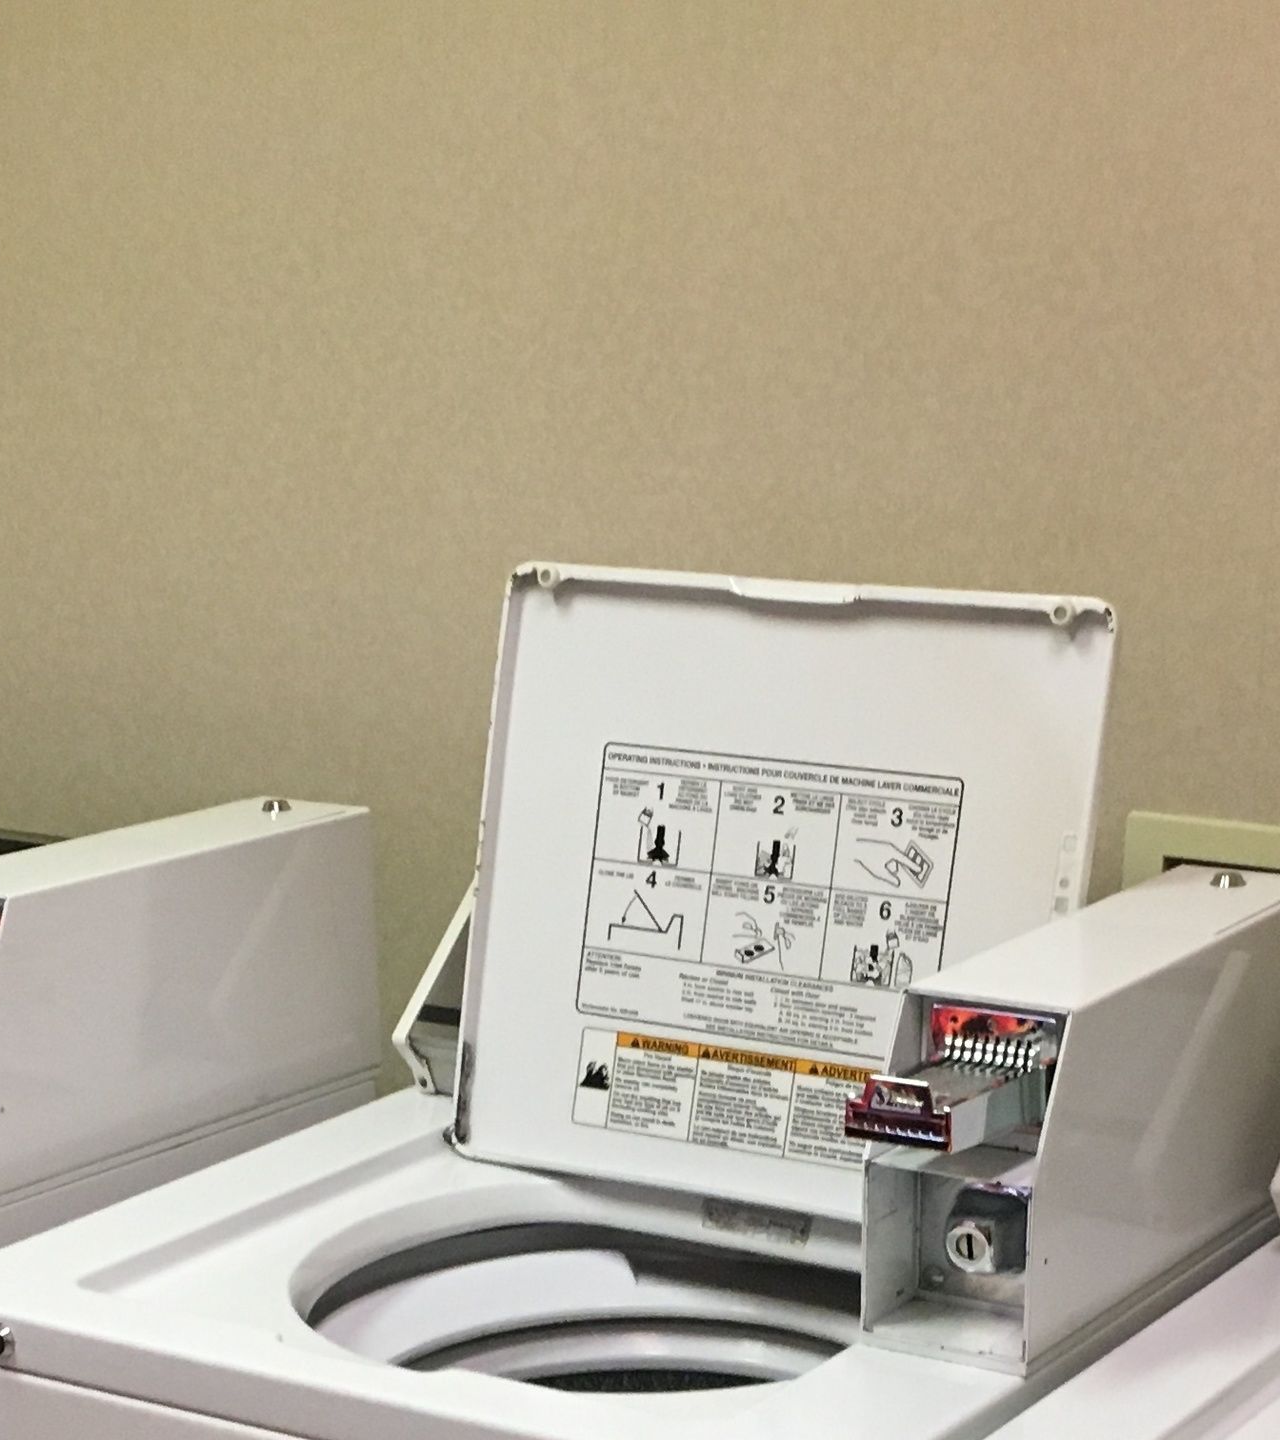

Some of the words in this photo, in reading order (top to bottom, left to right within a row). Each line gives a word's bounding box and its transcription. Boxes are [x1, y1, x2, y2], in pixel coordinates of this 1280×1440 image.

[655, 782, 665, 800] 1
[772, 795, 785, 815] 2
[890, 807, 904, 827] 3
[644, 870, 657, 888] 4
[762, 885, 776, 904] 5
[878, 900, 892, 920] 6
[640, 1038, 690, 1056] WARNING
[710, 1048, 794, 1072] AVERTISSEMENT
